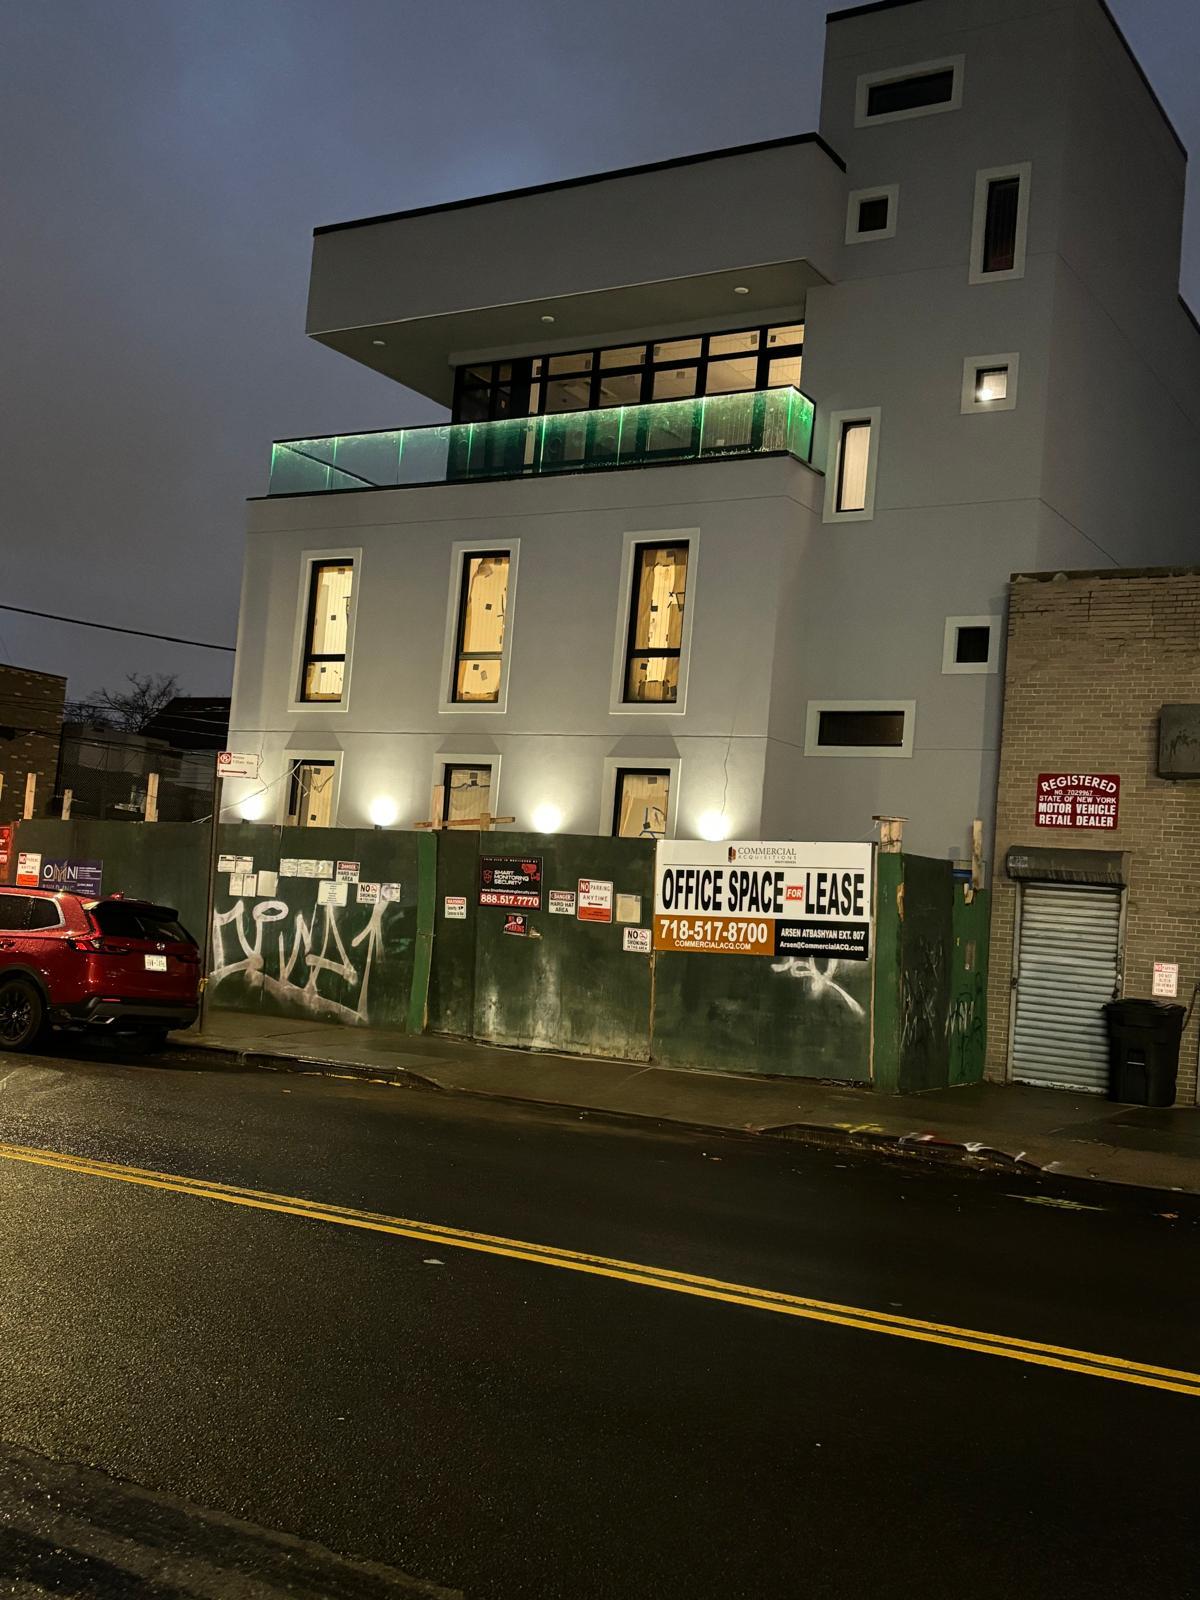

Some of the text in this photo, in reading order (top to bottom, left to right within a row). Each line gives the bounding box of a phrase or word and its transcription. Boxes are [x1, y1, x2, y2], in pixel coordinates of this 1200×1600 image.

[1041, 775, 1117, 793] REGISTERED
[1067, 789, 1093, 797] 7029967
[1038, 802, 1116, 815] MOTOR VEHICLE
[1039, 814, 1114, 827] RETAIL DEALER
[738, 847, 797, 856] COMMERCIAL
[43, 861, 78, 882] OMNI
[360, 884, 370, 893] NO
[580, 881, 610, 893] NO PARKING
[662, 868, 723, 911] OFFICE
[728, 870, 784, 913] SPACE
[787, 889, 802, 898] FOR
[805, 872, 865, 916] LEASE
[480, 894, 539, 906] 888.517.7770
[551, 893, 573, 901] DANGER
[627, 930, 638, 939] NO
[660, 919, 768, 943] 718-517-8700
[780, 928, 801, 937] ARSEN
[802, 929, 838, 939] ATBASHYAN
[839, 930, 851, 940] EXT.
[627, 939, 648, 947] SMOKING
[674, 939, 752, 950] COMMERCIALACQ.COM
[780, 941, 864, 952] Arsen@CommercialACQ.com
